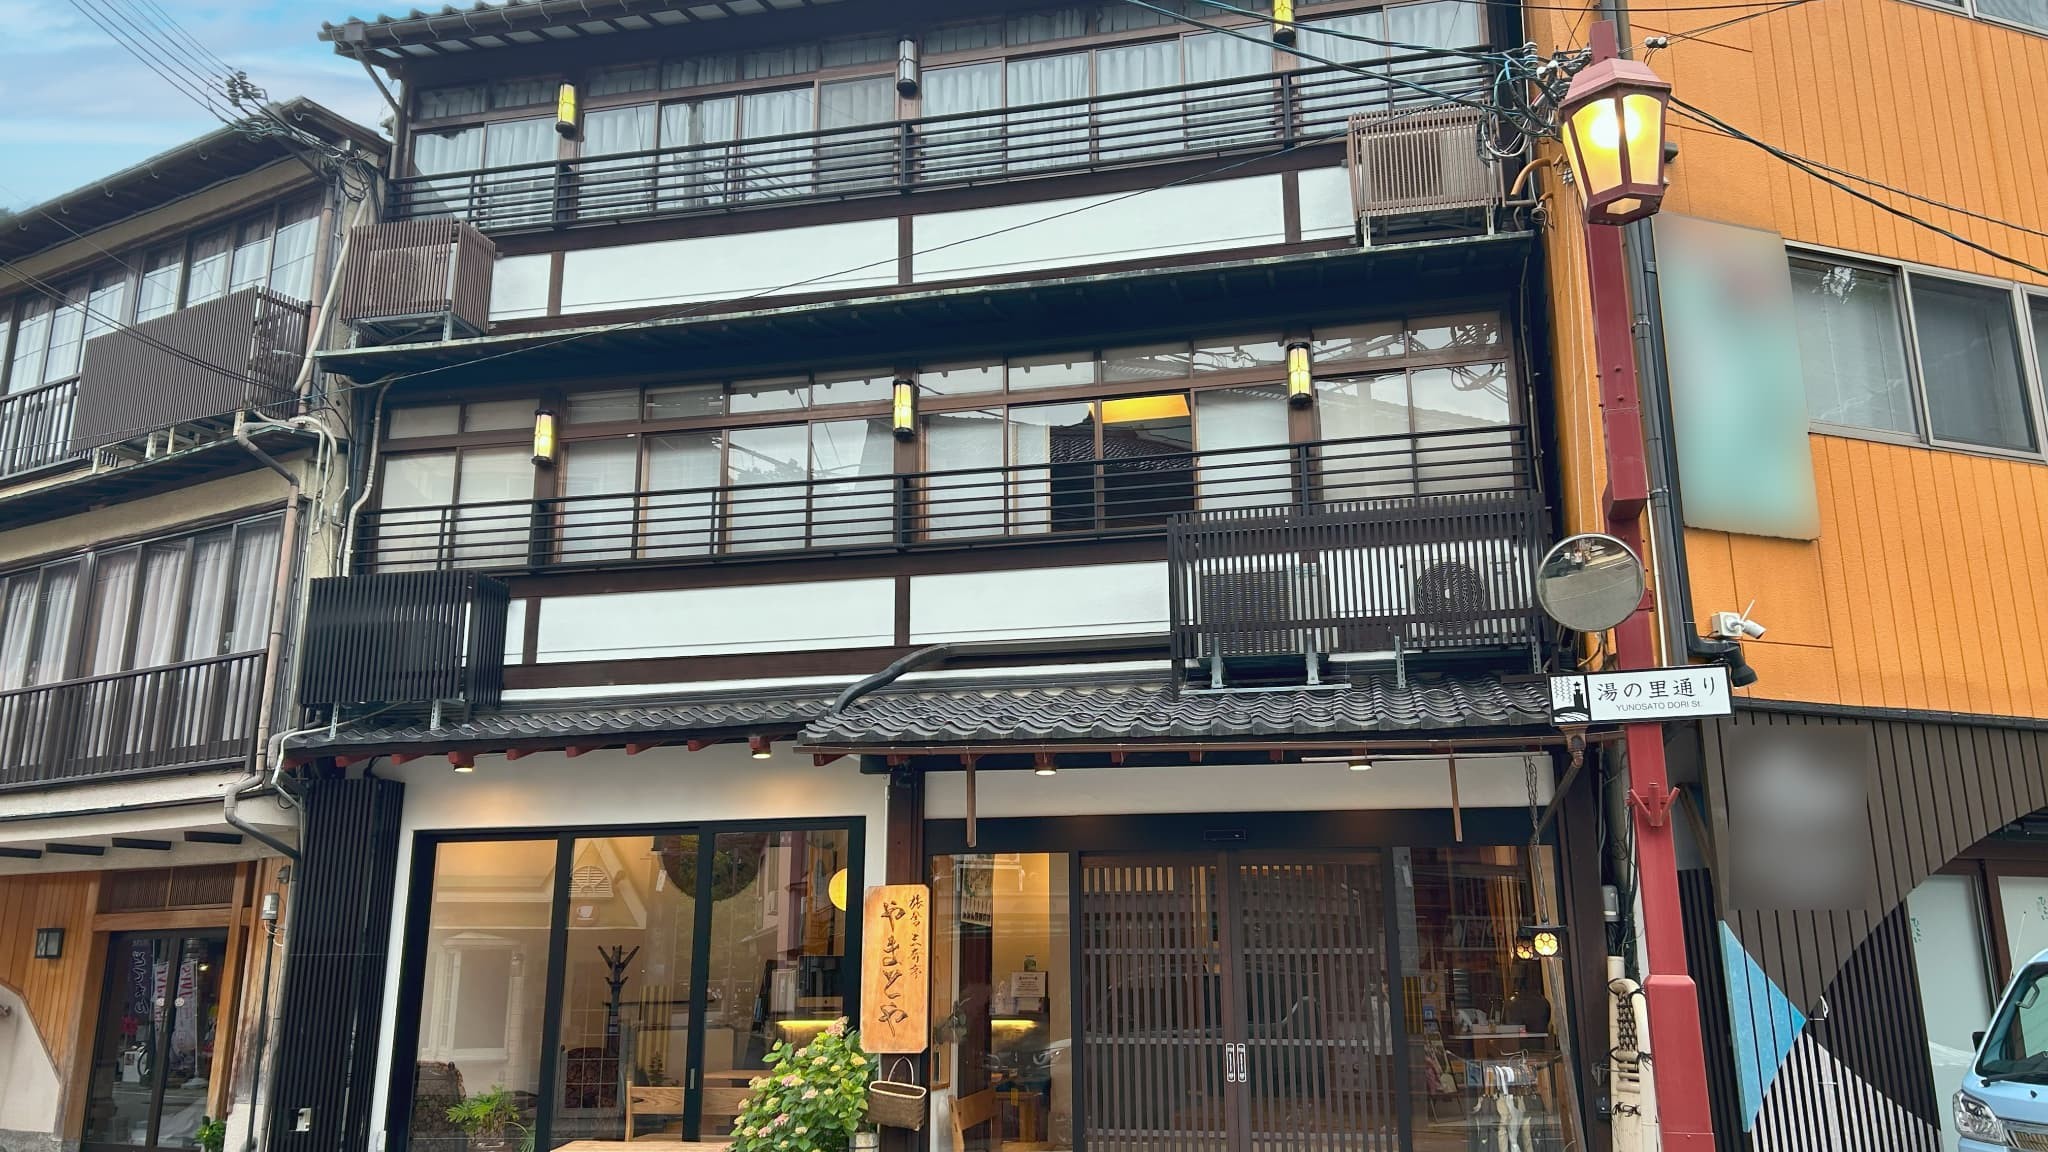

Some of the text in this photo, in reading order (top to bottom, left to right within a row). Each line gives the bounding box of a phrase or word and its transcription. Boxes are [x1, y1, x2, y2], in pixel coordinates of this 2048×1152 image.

[1597, 676, 1716, 702] 湯の里通り
[1616, 702, 1666, 712] YUNOSATO
[1667, 701, 1690, 709] DORI
[878, 900, 909, 1038] やまとや
